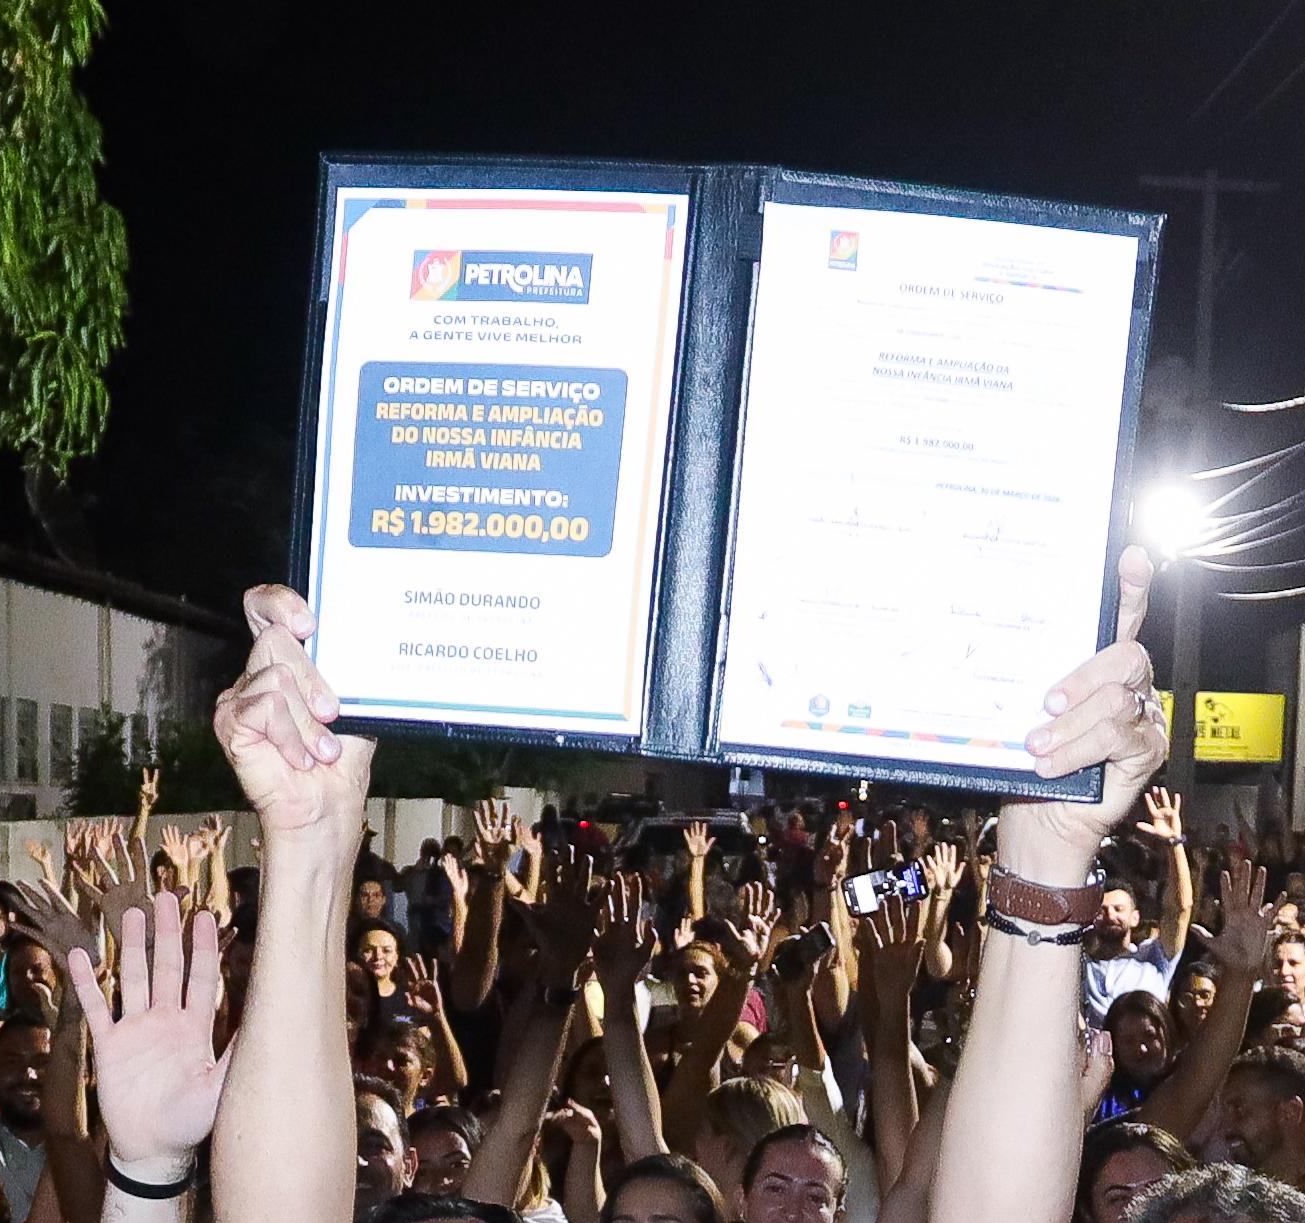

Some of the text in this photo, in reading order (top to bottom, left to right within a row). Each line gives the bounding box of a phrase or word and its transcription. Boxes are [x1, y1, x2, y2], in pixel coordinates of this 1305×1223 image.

[464, 263, 584, 293] PETROLINA
[526, 286, 584, 297] PREFEITURA
[899, 282, 940, 297] ORDEM
[960, 288, 1004, 305] SERVIÇO
[433, 315, 559, 328] COM TRABALHO,
[409, 330, 582, 344] A GENTE VIVE MELHOR
[872, 366, 904, 378] NOSSA
[383, 376, 601, 404] ORDEM DE SERVIÇO
[376, 402, 604, 429] REFORMA E AMPLIAÇÃO
[391, 425, 583, 449] DO NOSSA INFÂNCIA
[426, 448, 542, 471] IRMÃ VIANA
[395, 484, 569, 509] INVESTIMENTO:
[371, 507, 589, 543] R$ 1.982.000,00
[404, 587, 541, 610] SIMÃO DURANDO
[399, 642, 538, 663] RICARDO COELHO
